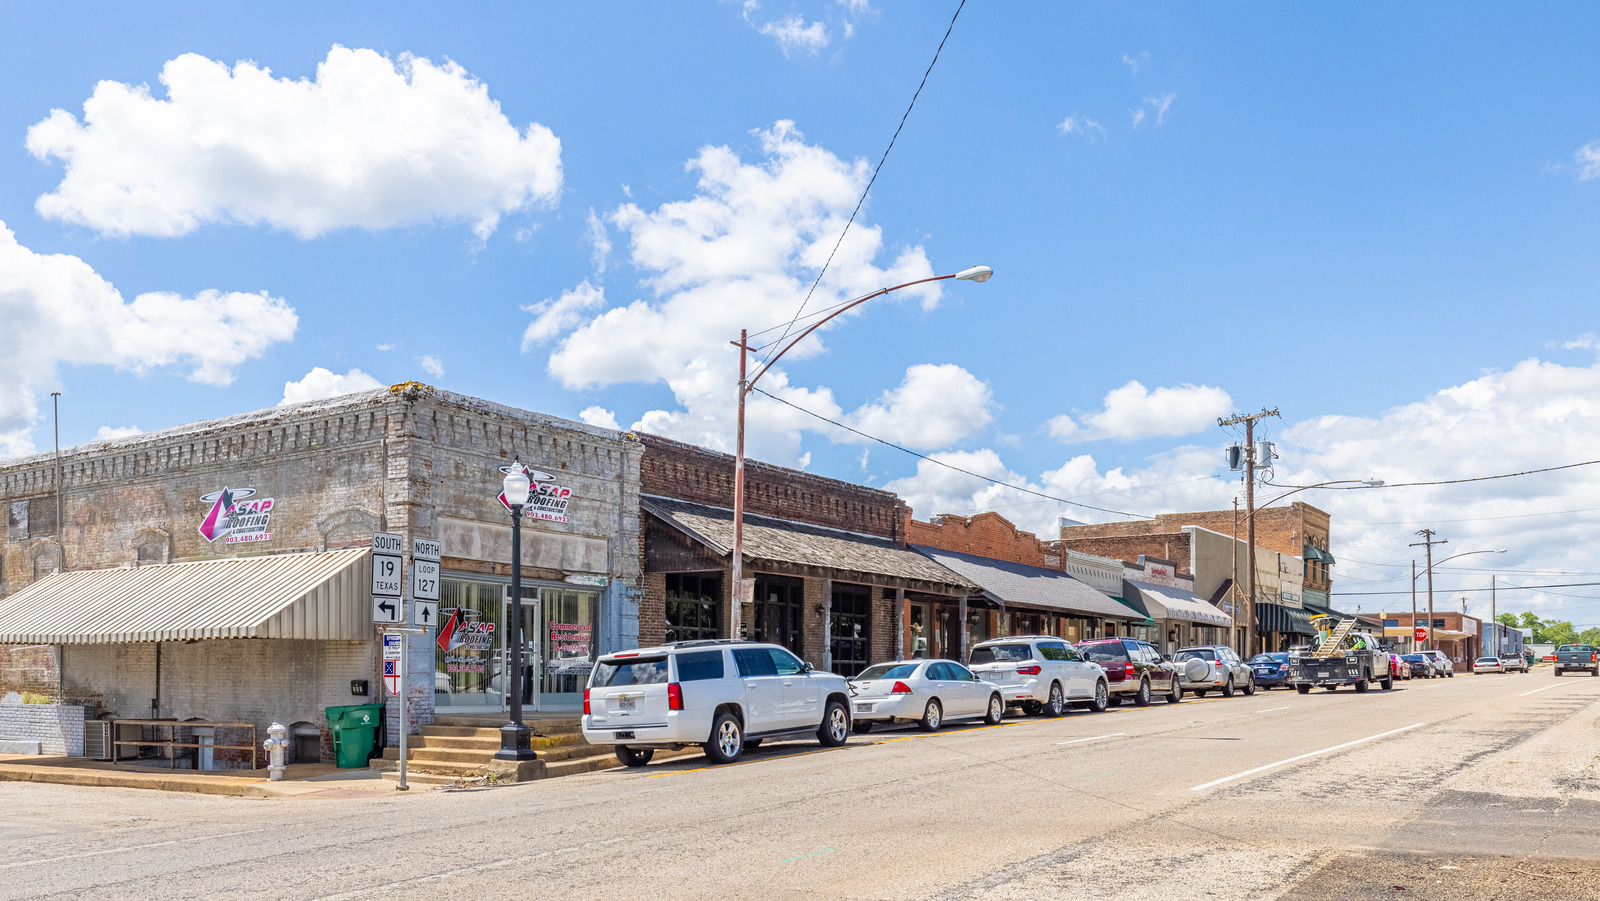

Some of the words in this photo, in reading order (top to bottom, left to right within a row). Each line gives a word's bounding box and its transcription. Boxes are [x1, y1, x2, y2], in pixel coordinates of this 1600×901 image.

[529, 483, 570, 498] ASAP
[527, 496, 567, 508] ROOFING
[224, 501, 272, 517] ASAP
[225, 515, 269, 528] ROOFING
[526, 512, 570, 523] 903.480.6933
[225, 534, 272, 543] 903.480.6933
[374, 536, 401, 551] SOUTH
[415, 542, 440, 556] NORTH
[381, 560, 394, 577] 19
[419, 565, 435, 574] LOOP
[376, 581, 399, 591] TEXAS
[418, 579, 435, 592] 127
[458, 622, 495, 634] ASAP
[550, 621, 592, 631] Commercial
[459, 635, 493, 645] ROOFING
[551, 632, 591, 641] Residential
[554, 643, 559, 651] &
[561, 643, 588, 653] Gutters
